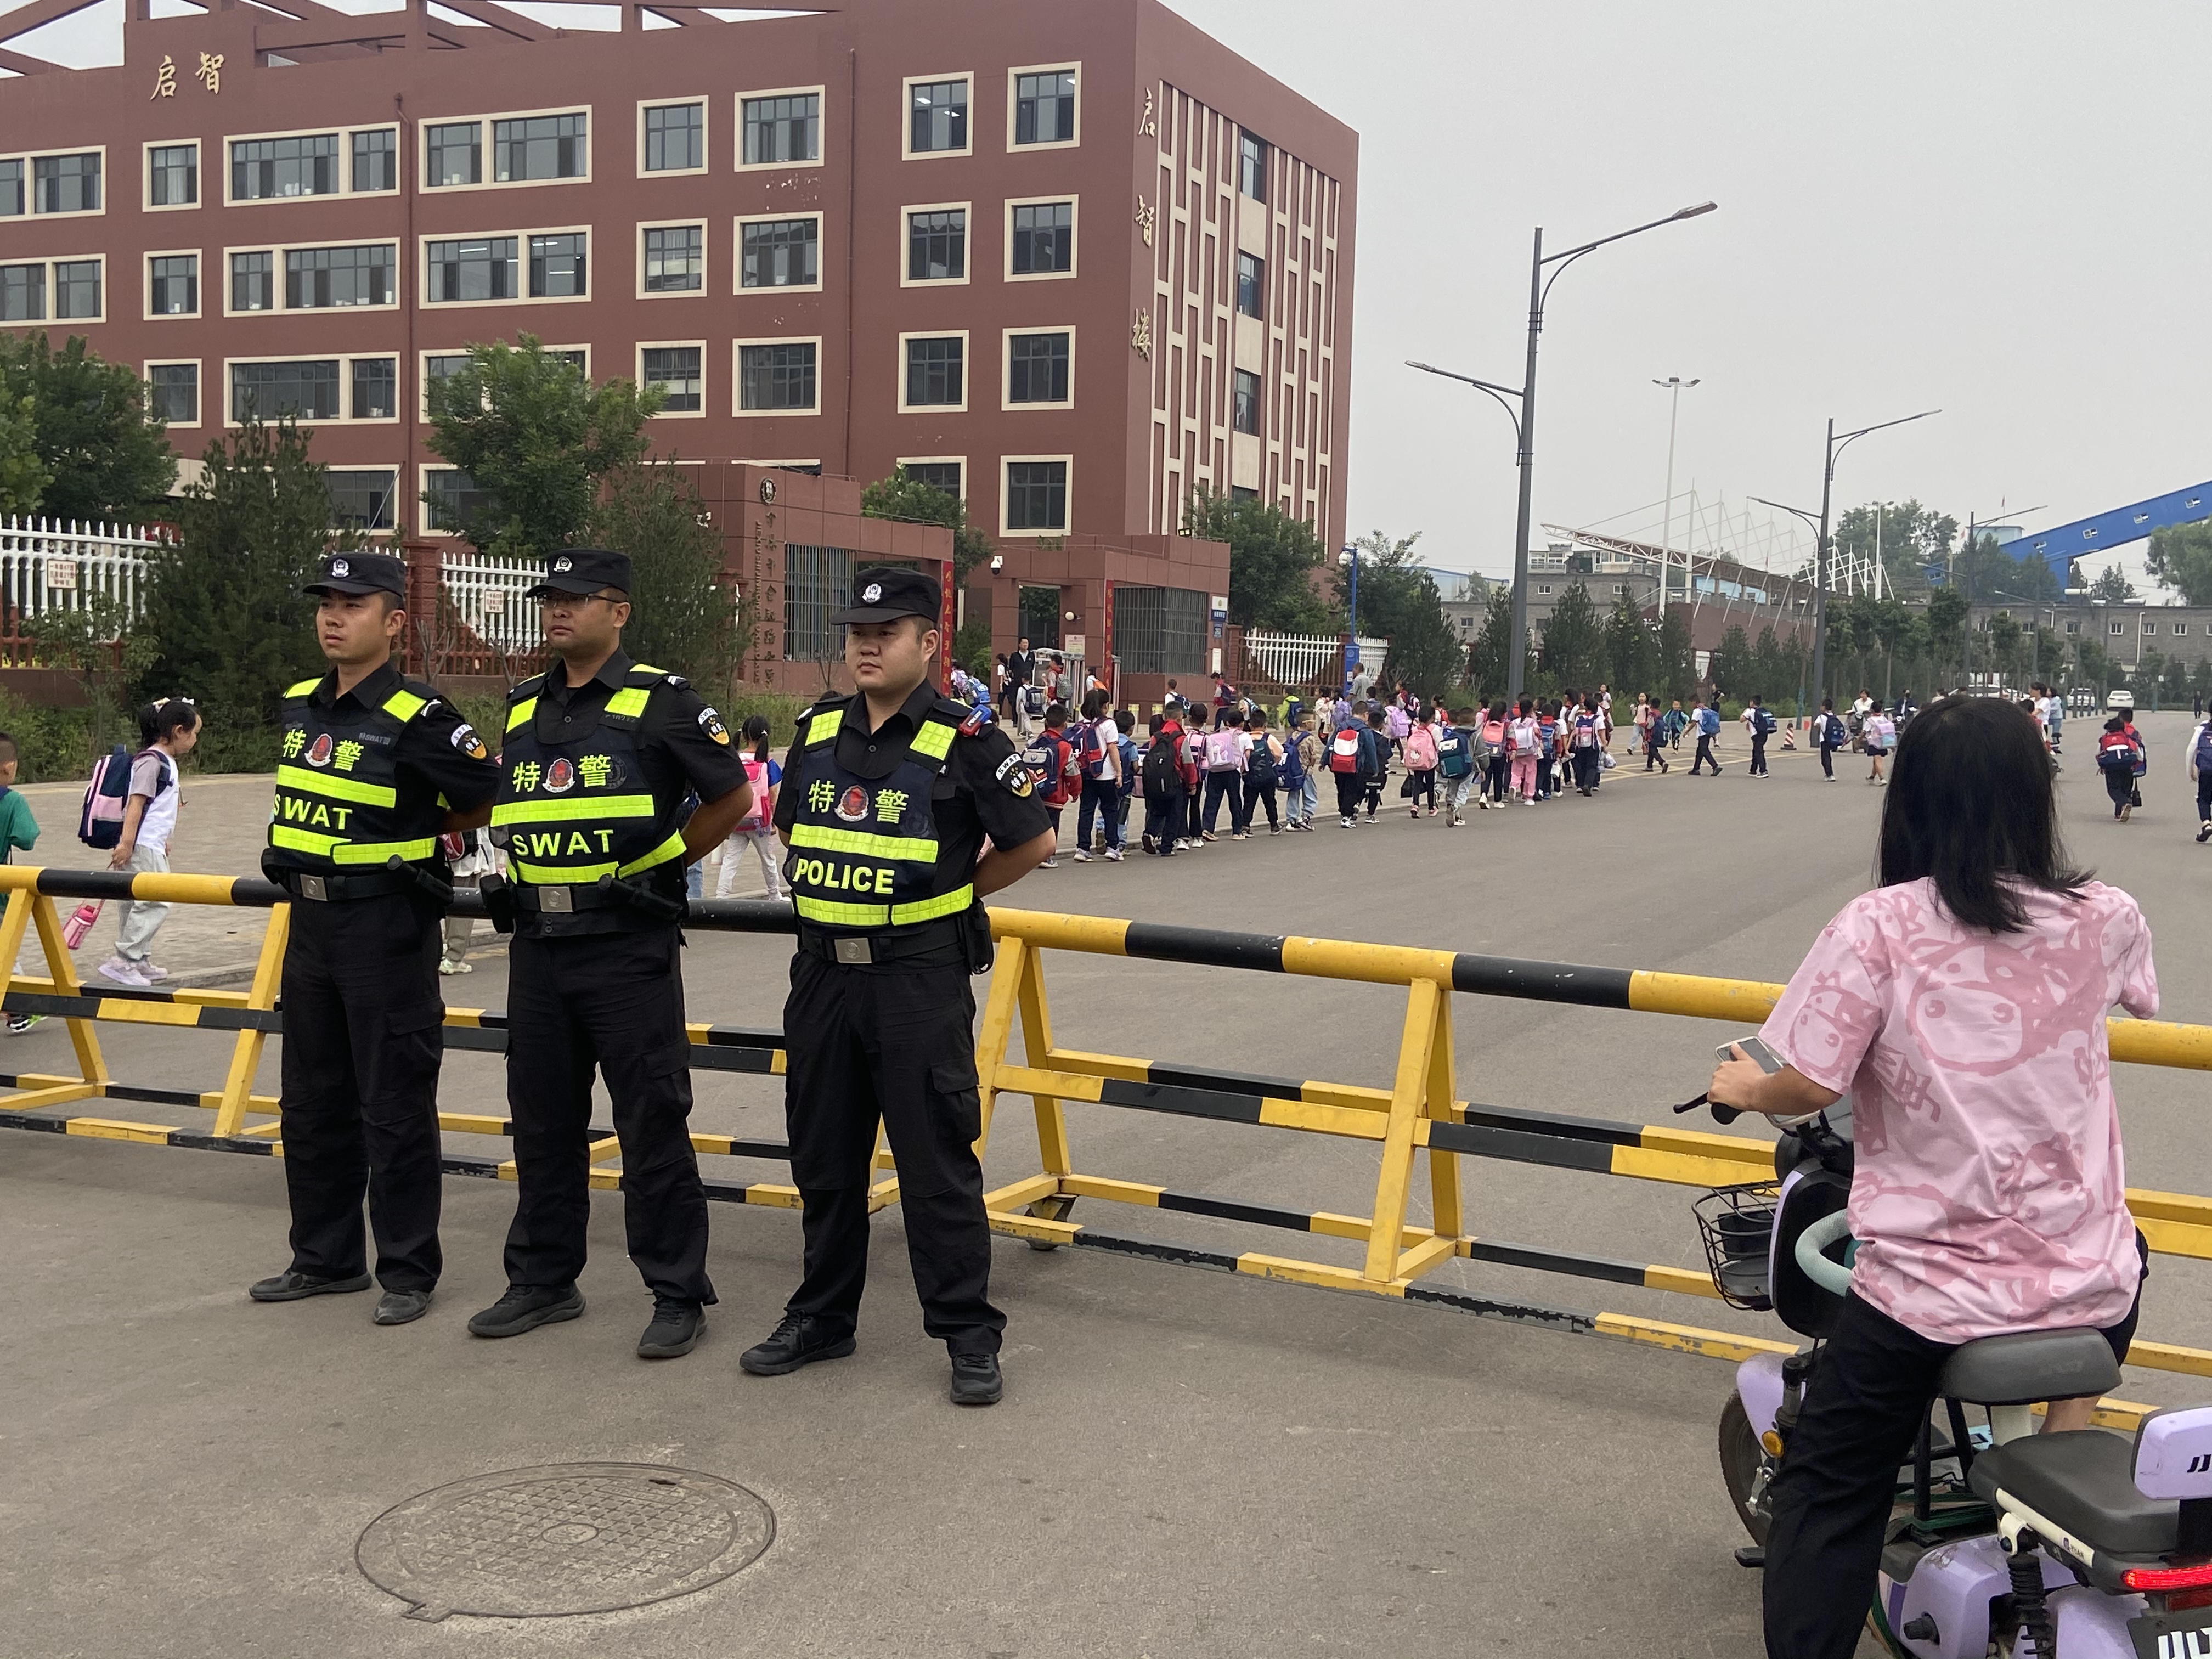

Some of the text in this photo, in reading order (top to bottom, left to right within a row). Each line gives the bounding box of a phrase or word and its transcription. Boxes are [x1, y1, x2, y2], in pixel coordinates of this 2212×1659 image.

[273, 793, 353, 831] SWAT
[512, 830, 614, 857] SWAT
[793, 857, 895, 894] POLICE
